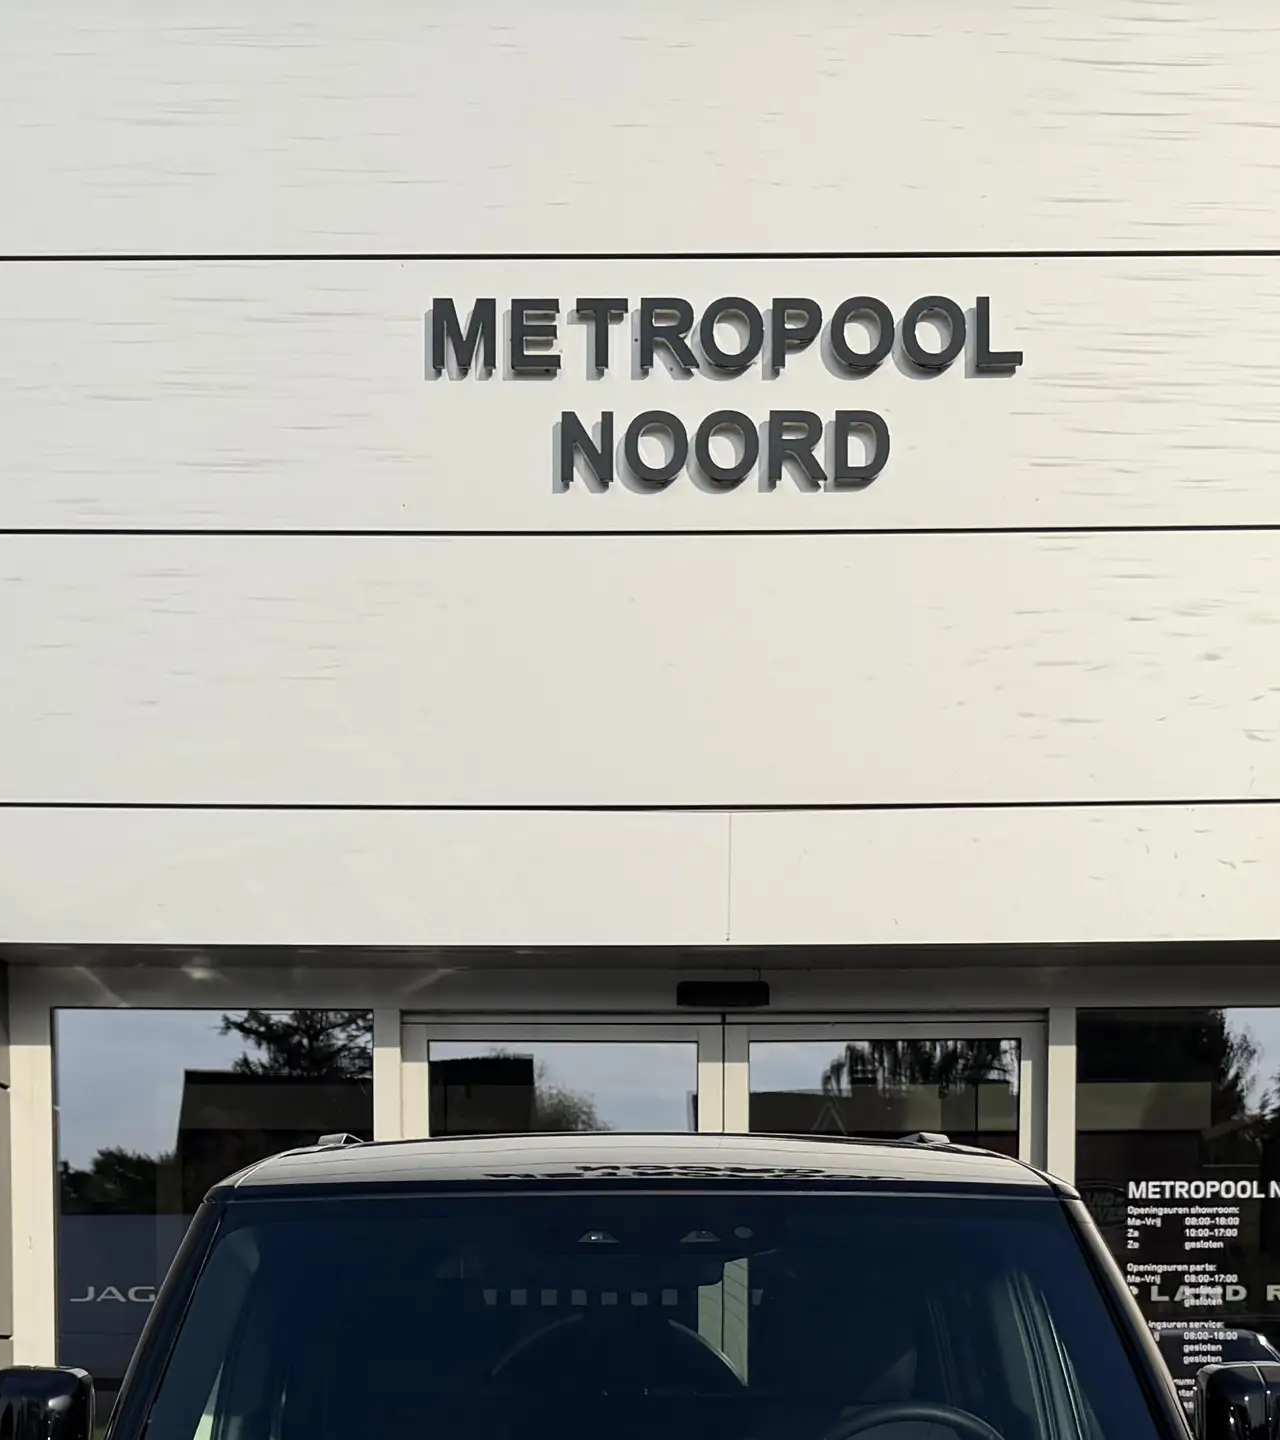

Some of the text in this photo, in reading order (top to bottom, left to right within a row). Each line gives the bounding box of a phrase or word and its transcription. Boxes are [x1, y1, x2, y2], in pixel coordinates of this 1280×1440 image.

[431, 295, 1024, 370] METROPOOL
[560, 409, 891, 485] NOORD
[1128, 1180, 1266, 1199] METROPOOL
[1127, 1205, 1240, 1216] Openingsuren showroom:
[1127, 1228, 1238, 1238] Za 10:00-17:00
[1184, 1239, 1224, 1251] gesloten
[1127, 1262, 1217, 1273] Openingsuren parts:
[69, 1285, 157, 1303] JAG
[1148, 1319, 1224, 1330] ingsuren service:
[1183, 1342, 1222, 1353] gesloten
[1183, 1354, 1222, 1365] gesloten
